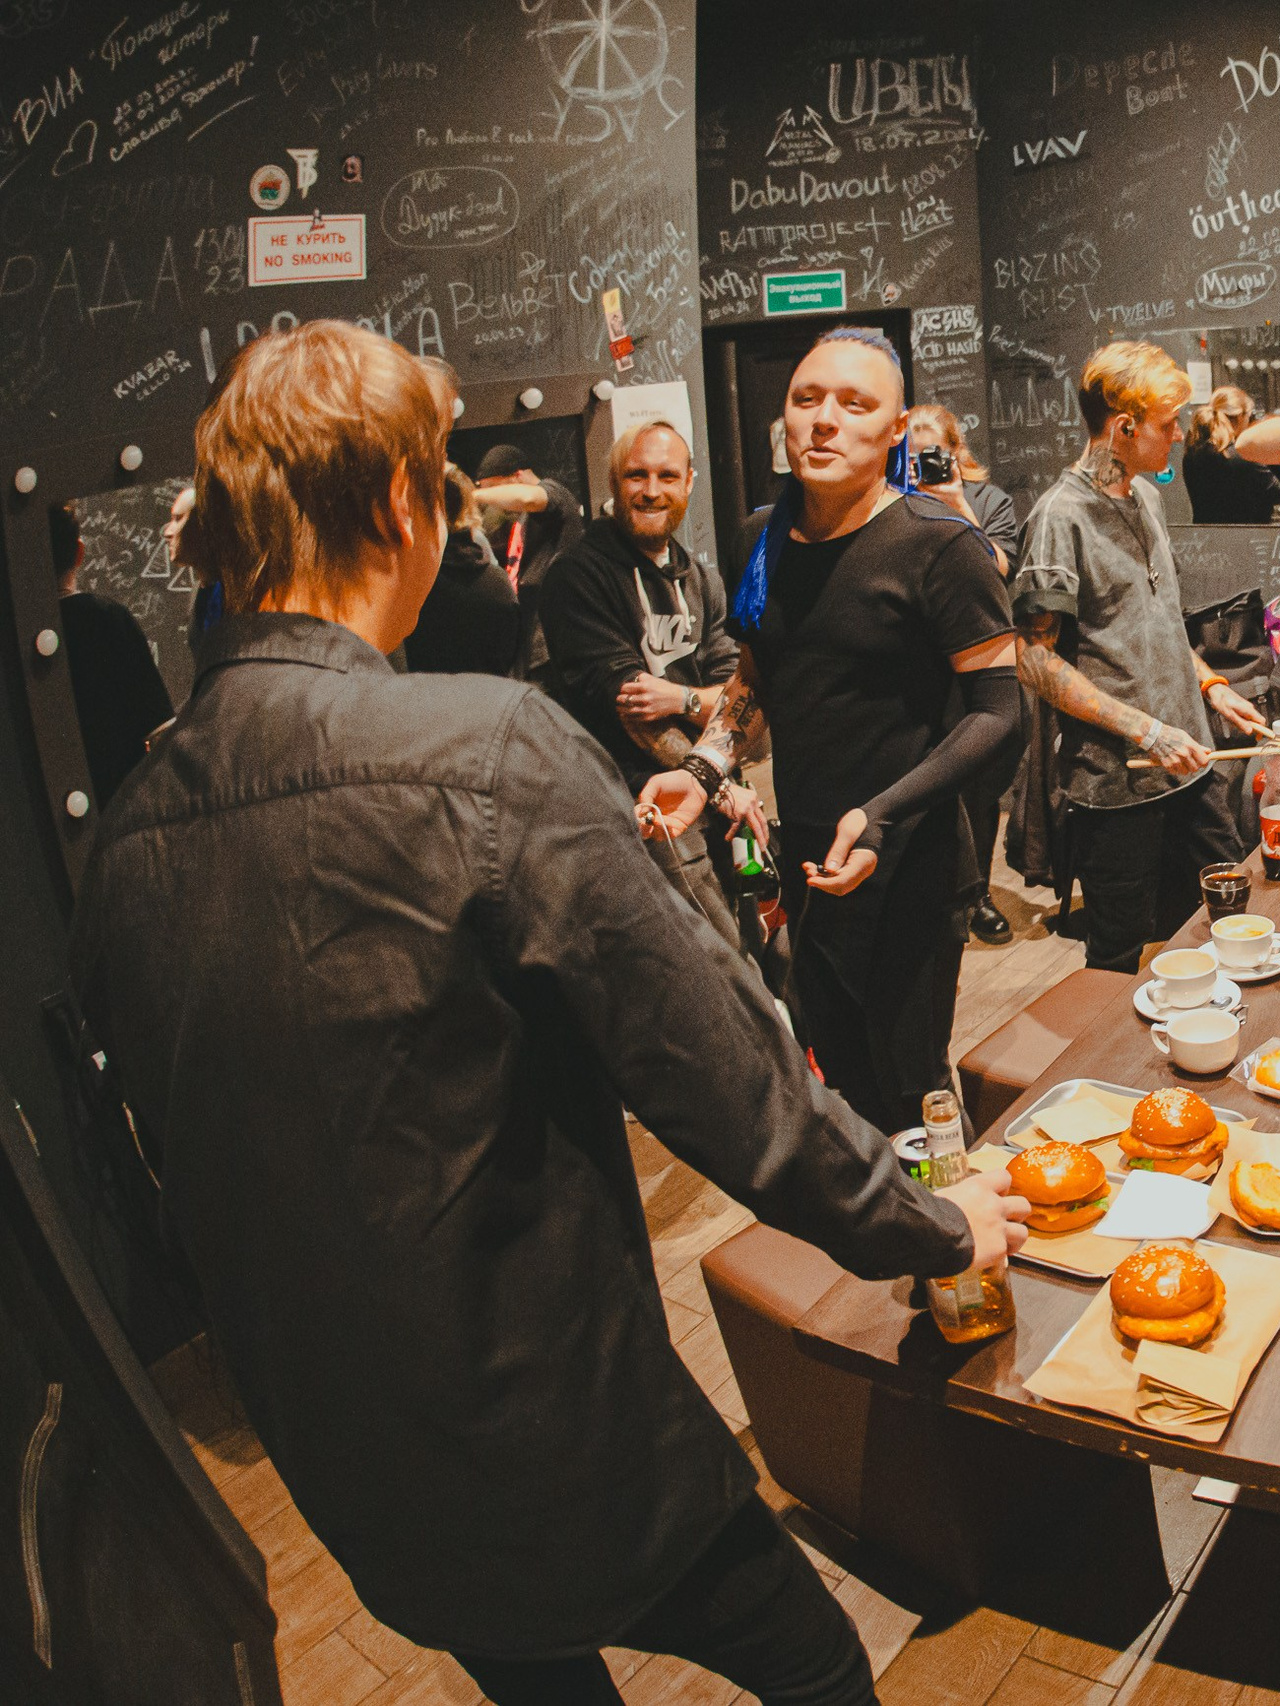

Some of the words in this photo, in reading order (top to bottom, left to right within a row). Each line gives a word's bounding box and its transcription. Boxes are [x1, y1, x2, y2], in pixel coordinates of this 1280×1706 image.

[13, 66, 83, 145] ВИА
[271, 235, 288, 246] НЕ
[296, 232, 346, 245] КУРИТЬ
[264, 256, 283, 267] NO
[291, 252, 352, 266] SMOKING
